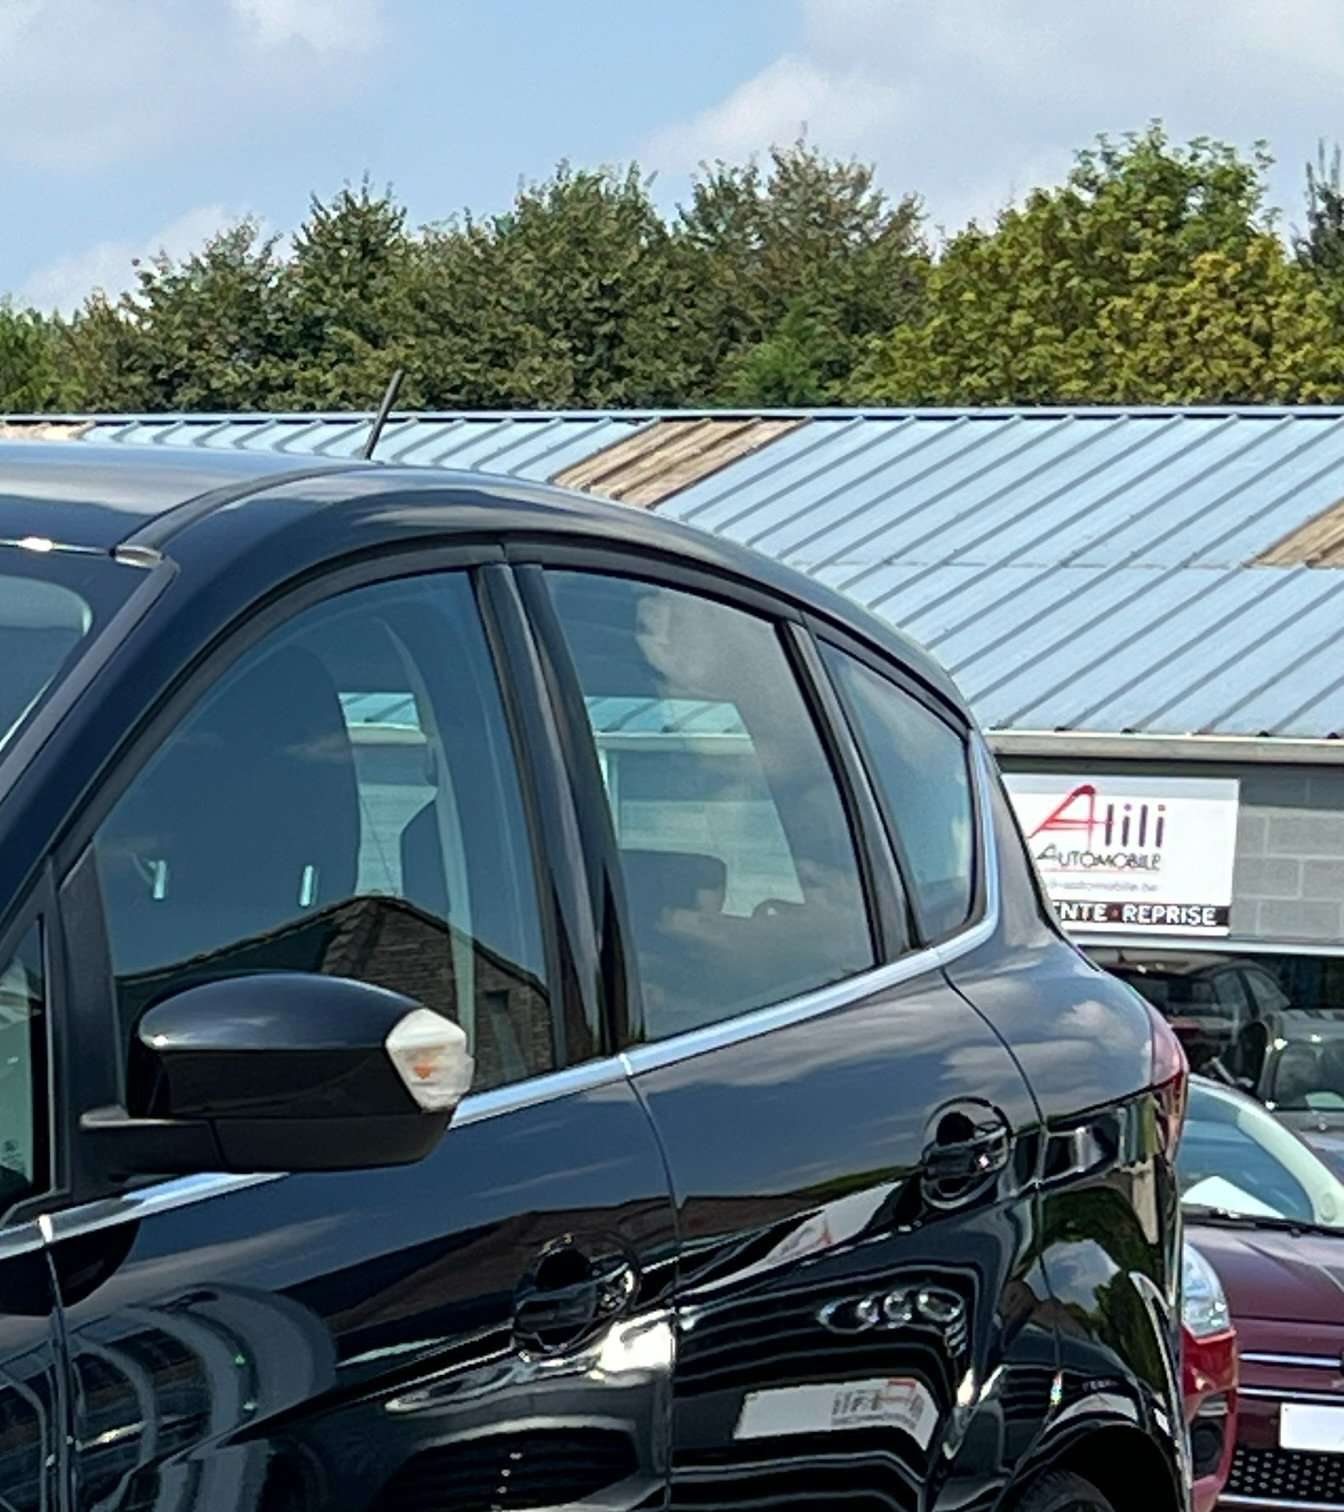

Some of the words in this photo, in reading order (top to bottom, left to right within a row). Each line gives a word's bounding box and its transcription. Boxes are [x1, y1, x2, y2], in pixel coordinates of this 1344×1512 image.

[1027, 785, 1166, 850] Alili
[1036, 843, 1161, 871] AUTOMOBILE
[1054, 902, 1108, 921] NTE
[1122, 903, 1217, 926] REPRISE
